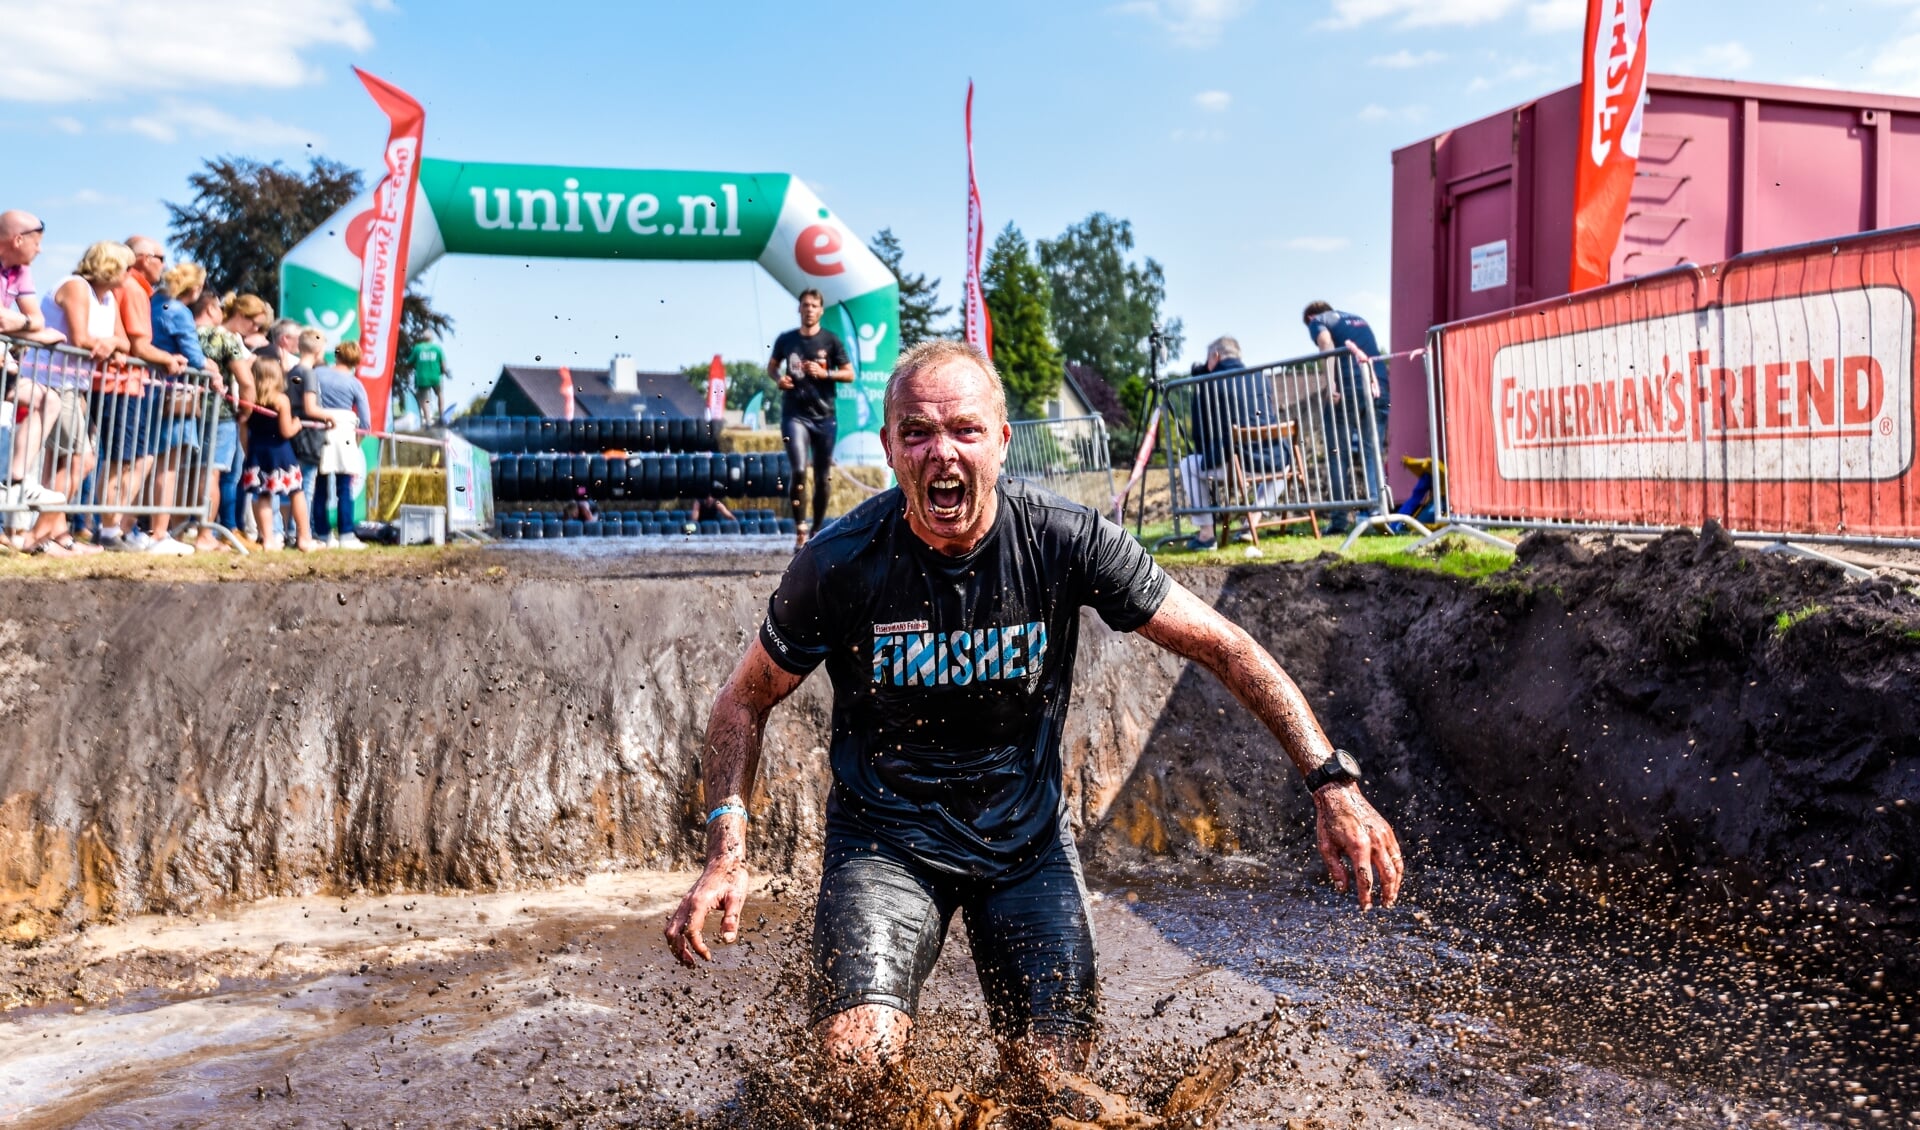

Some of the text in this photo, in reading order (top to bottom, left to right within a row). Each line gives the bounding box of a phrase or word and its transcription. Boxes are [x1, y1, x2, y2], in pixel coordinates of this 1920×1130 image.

[469, 177, 742, 236] unive.nl
[1501, 348, 1885, 450] FISHERMAN'S FRIEND
